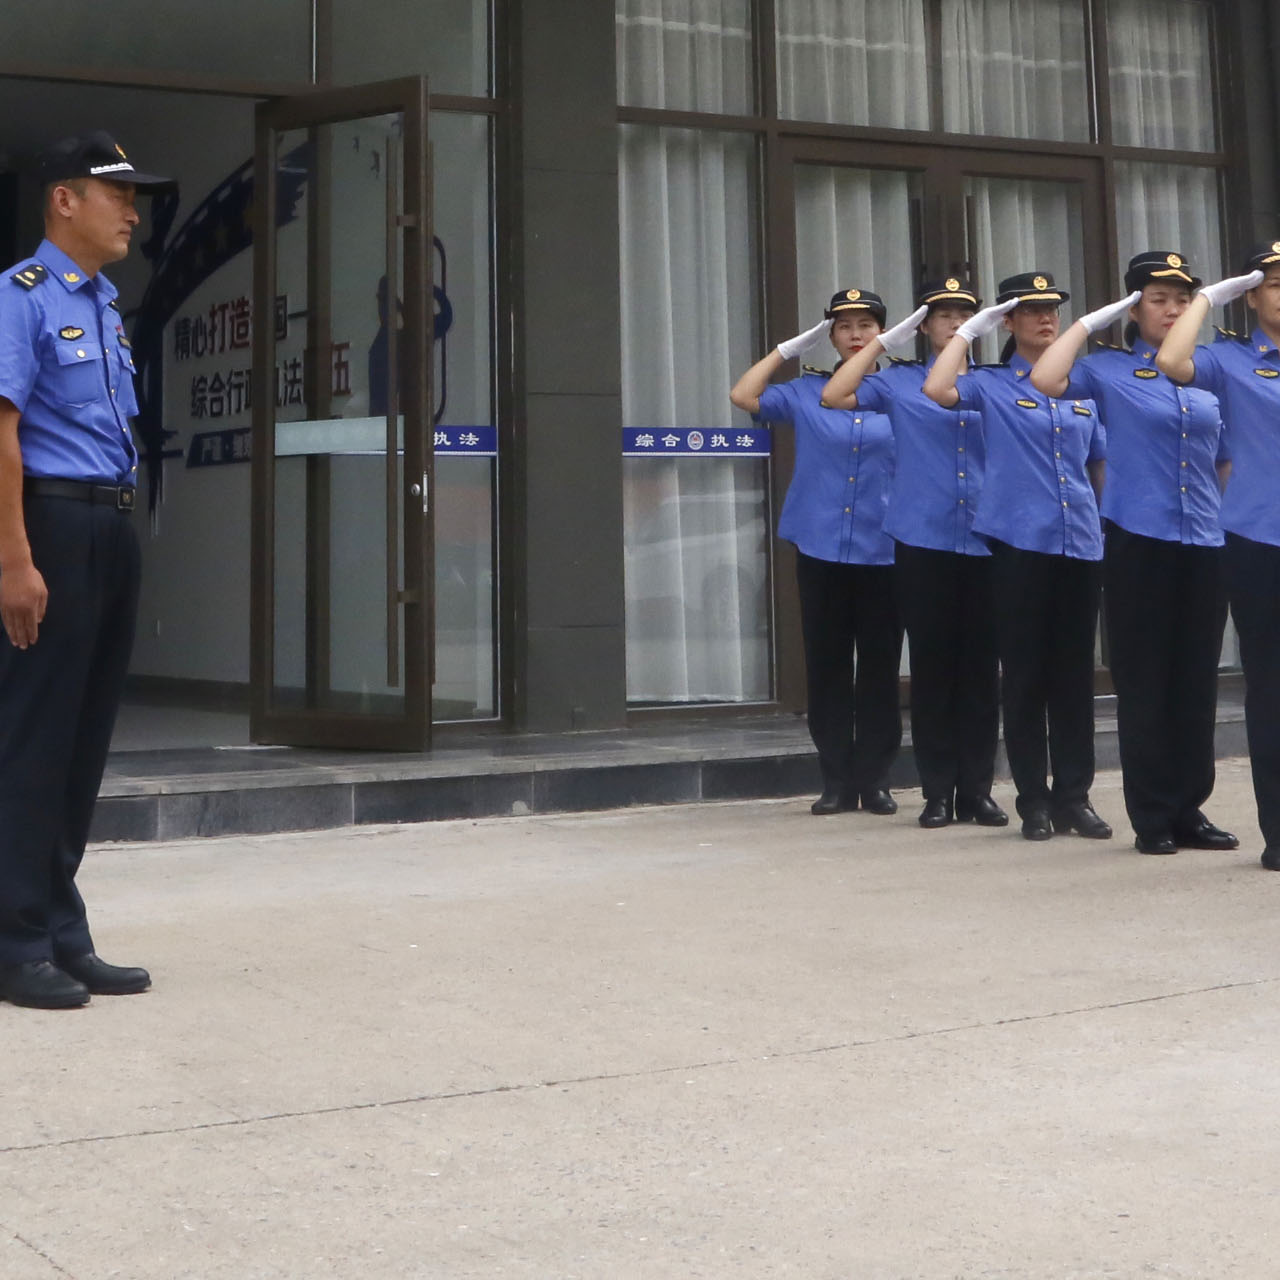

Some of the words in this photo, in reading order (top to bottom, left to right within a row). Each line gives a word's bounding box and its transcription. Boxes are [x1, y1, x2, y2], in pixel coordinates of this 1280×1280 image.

[433, 431, 480, 446] 执法
[635, 433, 681, 447] 综合
[710, 434, 754, 447] 执法
